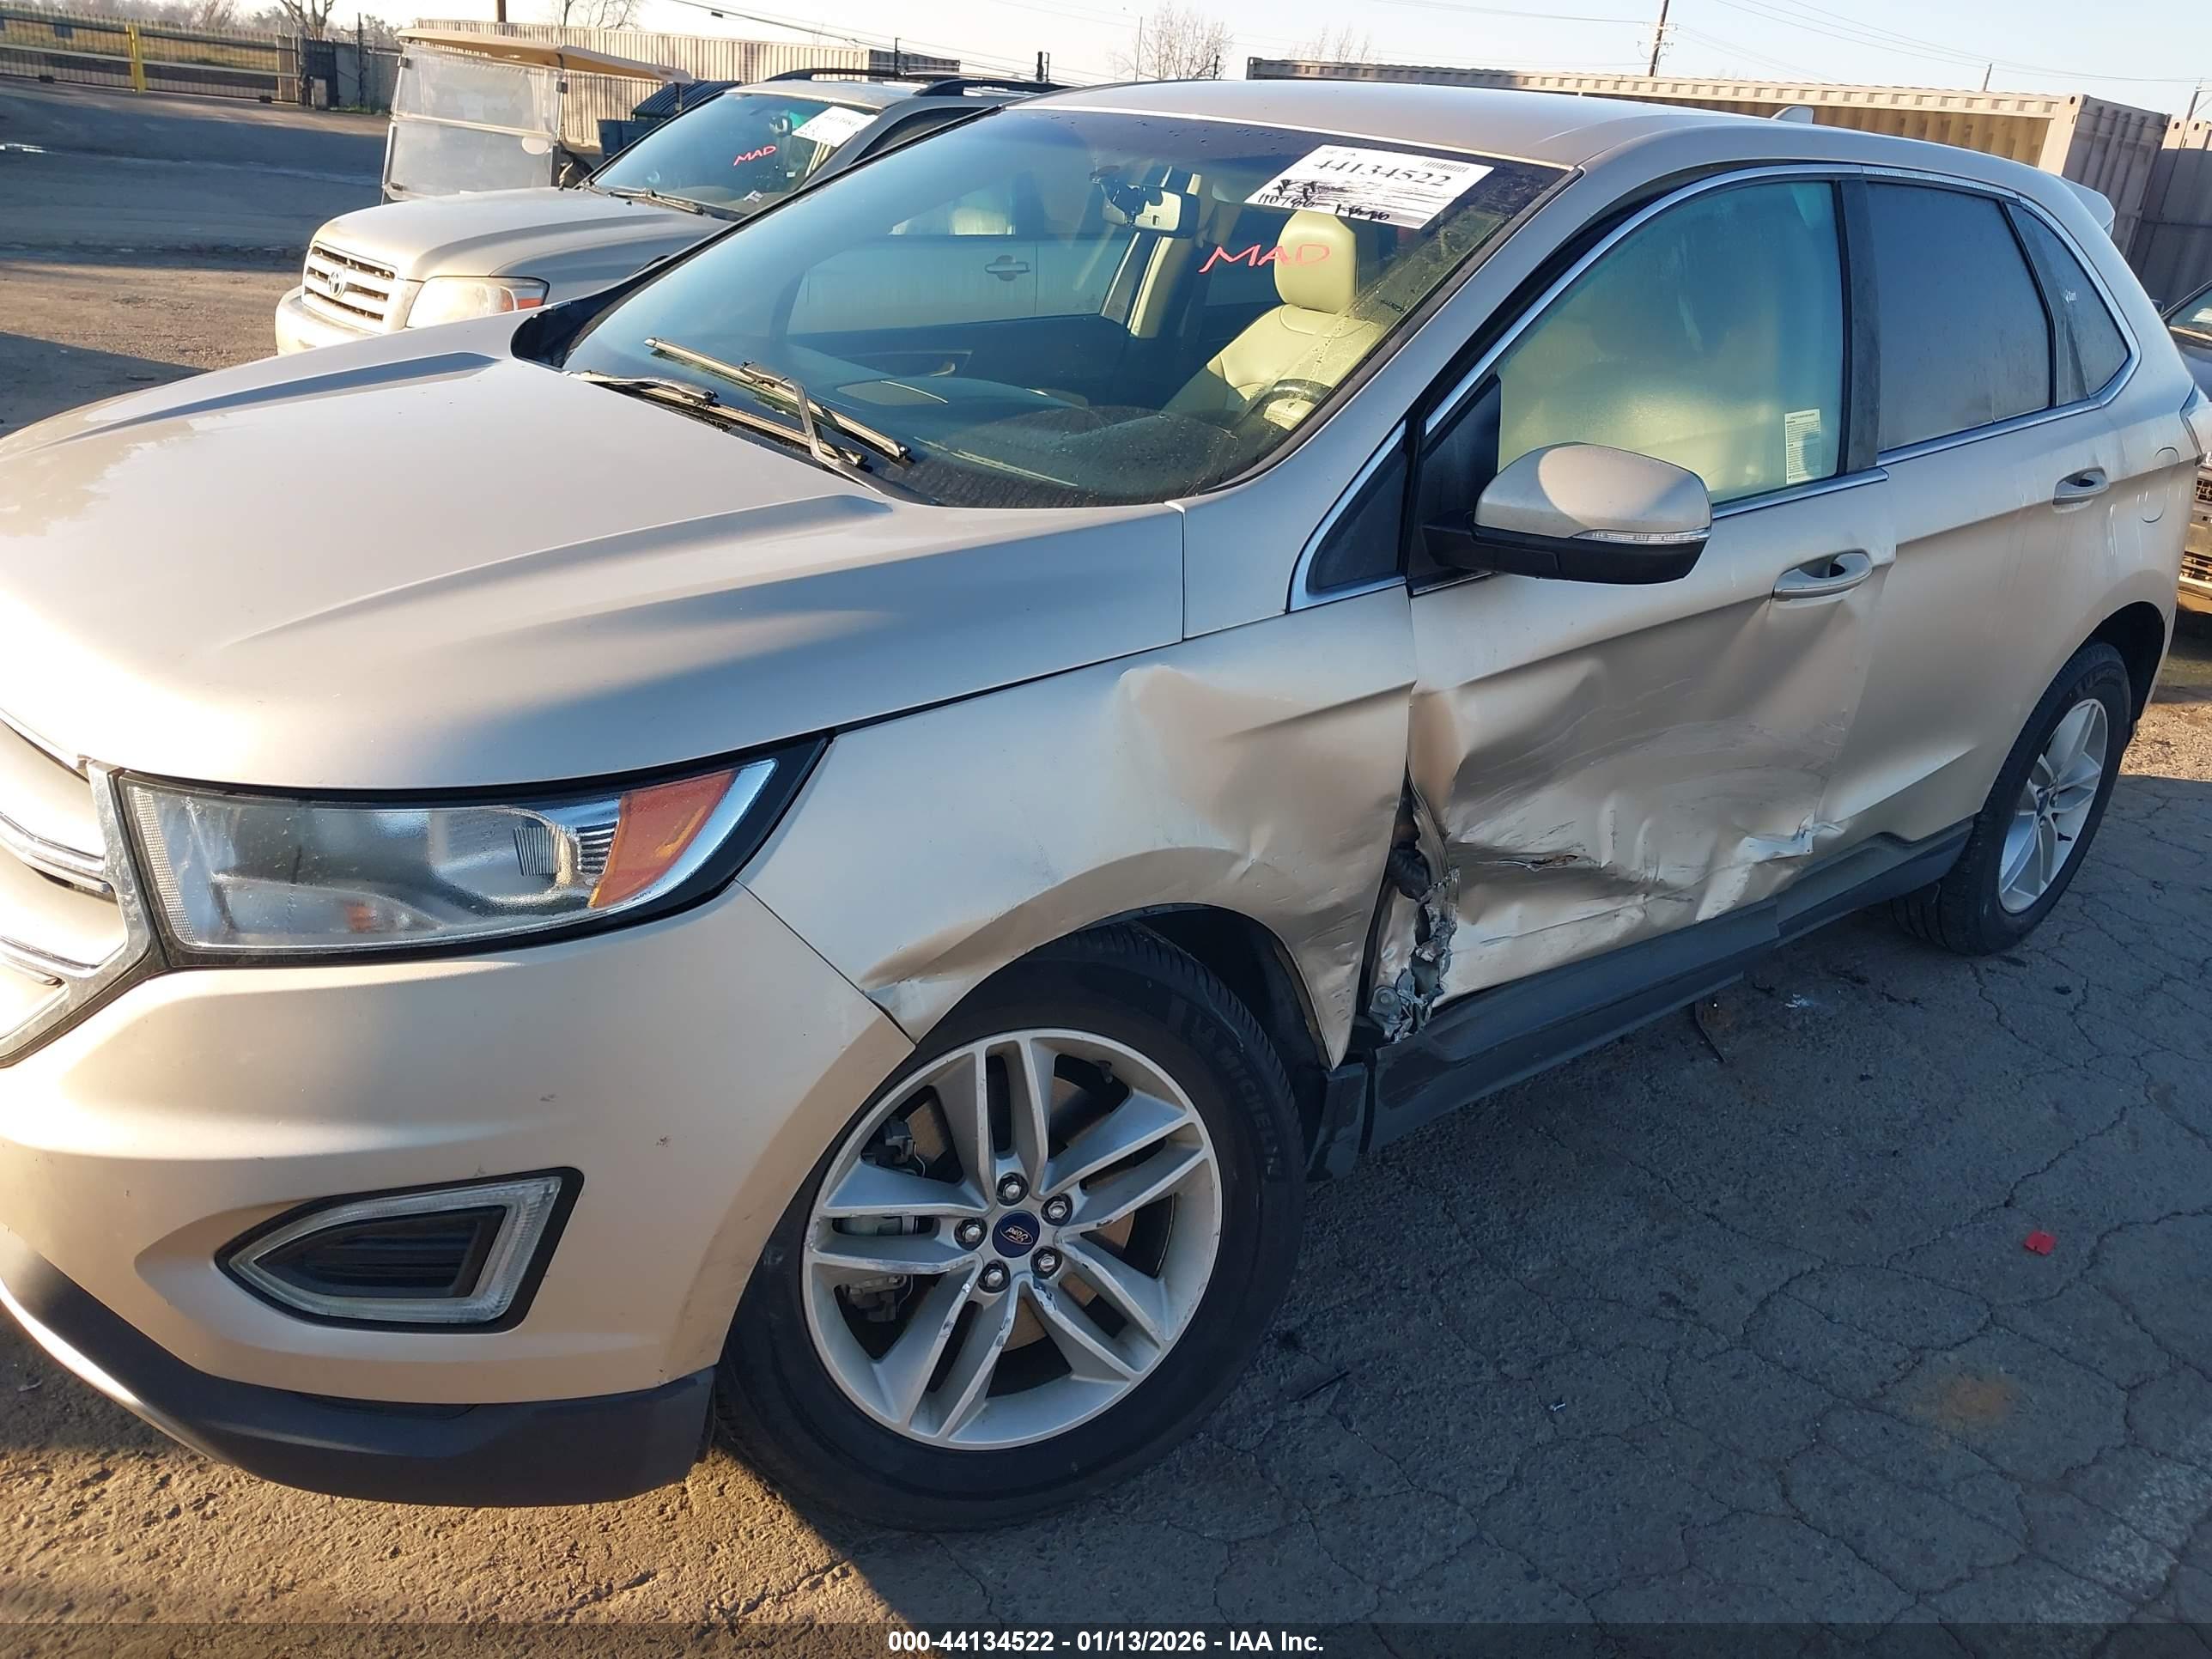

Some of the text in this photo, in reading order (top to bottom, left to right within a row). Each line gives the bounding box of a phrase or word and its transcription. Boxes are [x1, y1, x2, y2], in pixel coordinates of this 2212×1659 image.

[733, 145, 776, 167] MAD
[1314, 159, 1452, 187] 44134522
[1198, 243, 1330, 274] MAD
[1004, 1226, 1030, 1243] Ford
